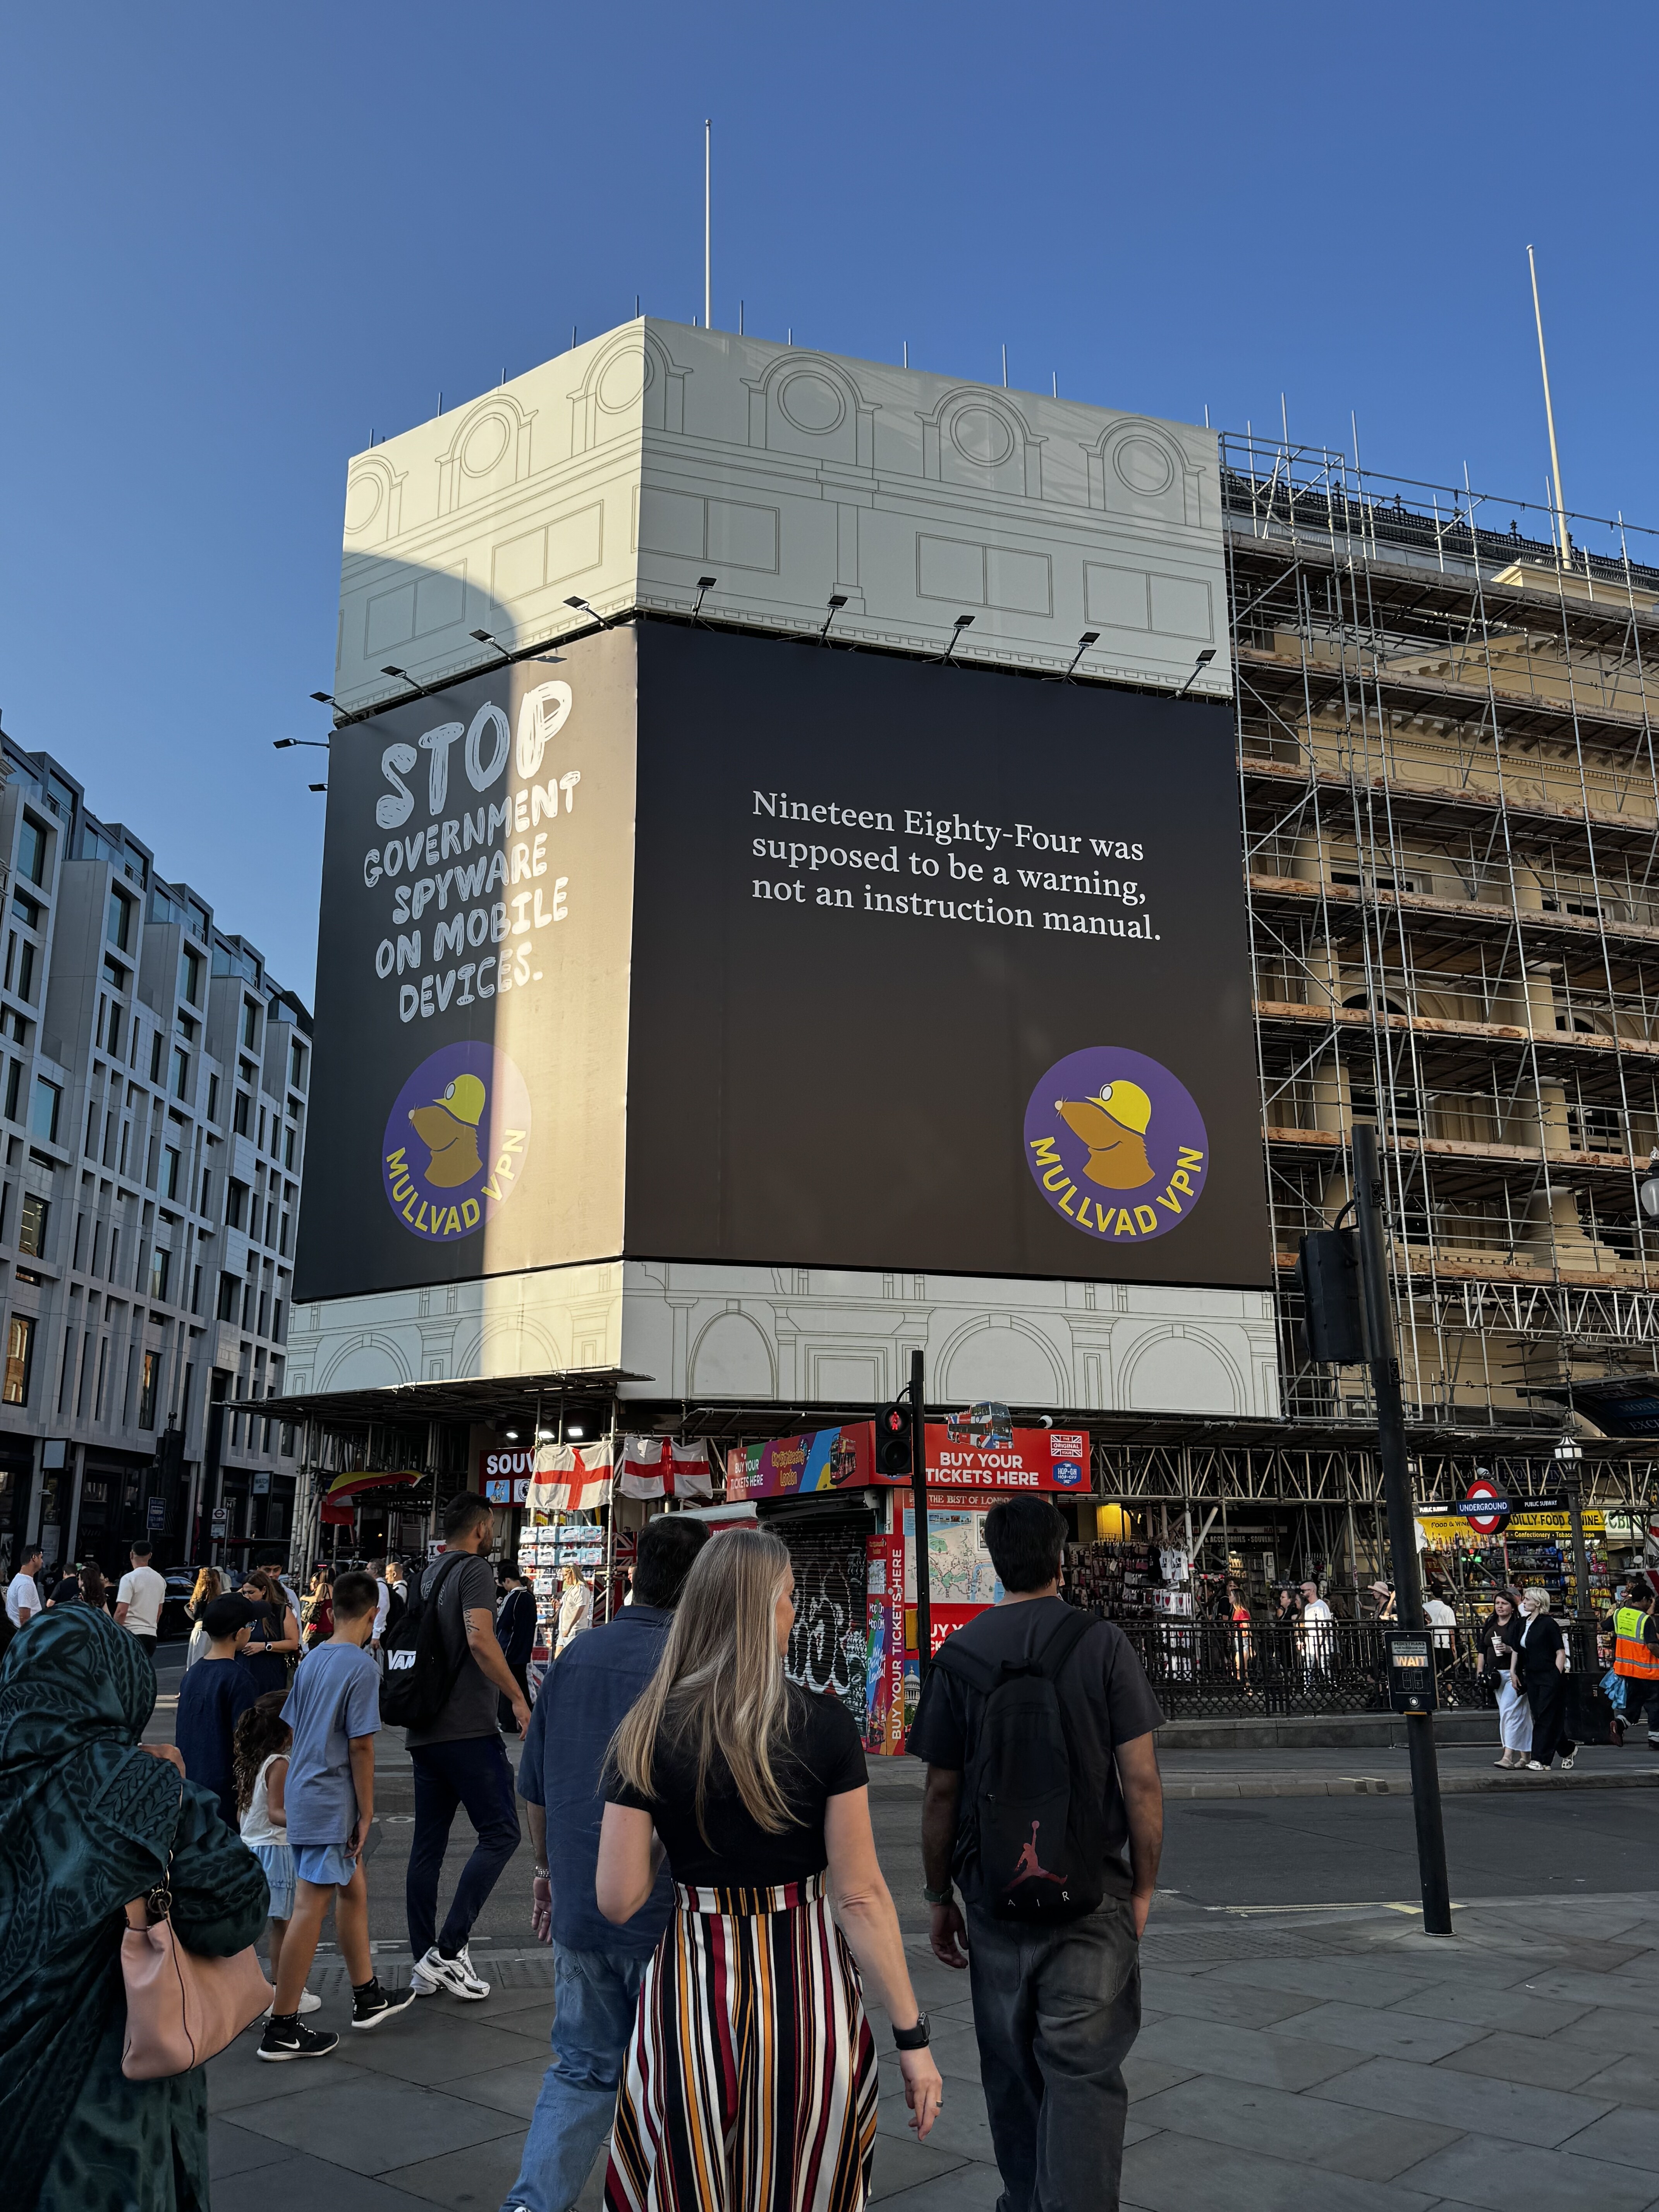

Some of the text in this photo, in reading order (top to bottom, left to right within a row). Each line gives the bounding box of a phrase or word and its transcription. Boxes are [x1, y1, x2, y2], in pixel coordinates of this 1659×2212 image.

[376, 680, 572, 829] STOP
[364, 771, 581, 887] GOVERNMENT
[752, 791, 1144, 860] Nineteen Eighty-Four was
[393, 832, 548, 925] SPYWARE
[752, 836, 1146, 906] supposed to be a warning,
[376, 876, 568, 979] ON MOBILE
[752, 878, 1161, 940] not an instruction manual.
[400, 941, 543, 1023] DEVICES.
[386, 1128, 527, 1235] MULLVAD VPN
[1030, 1136, 1203, 1236] MULLVAD VPN
[730, 1474, 764, 1489] TICKETS HERE
[735, 1458, 759, 1474] BUY YOUR
[926, 1468, 1039, 1486] TICKETS HERE
[940, 1452, 1023, 1469] BUY YOUR
[929, 1495, 944, 1503] THE
[969, 1496, 979, 1504] OF
[981, 1496, 1013, 1505] LONDO
[1459, 1502, 1508, 1512] UNDERGROUND
[1540, 1515, 1565, 1526] FOOD
[892, 1549, 902, 1740] BUY YOUR TICKETS HERE
[931, 1624, 949, 1638] UY
[1396, 1656, 1426, 1667] WAIT
